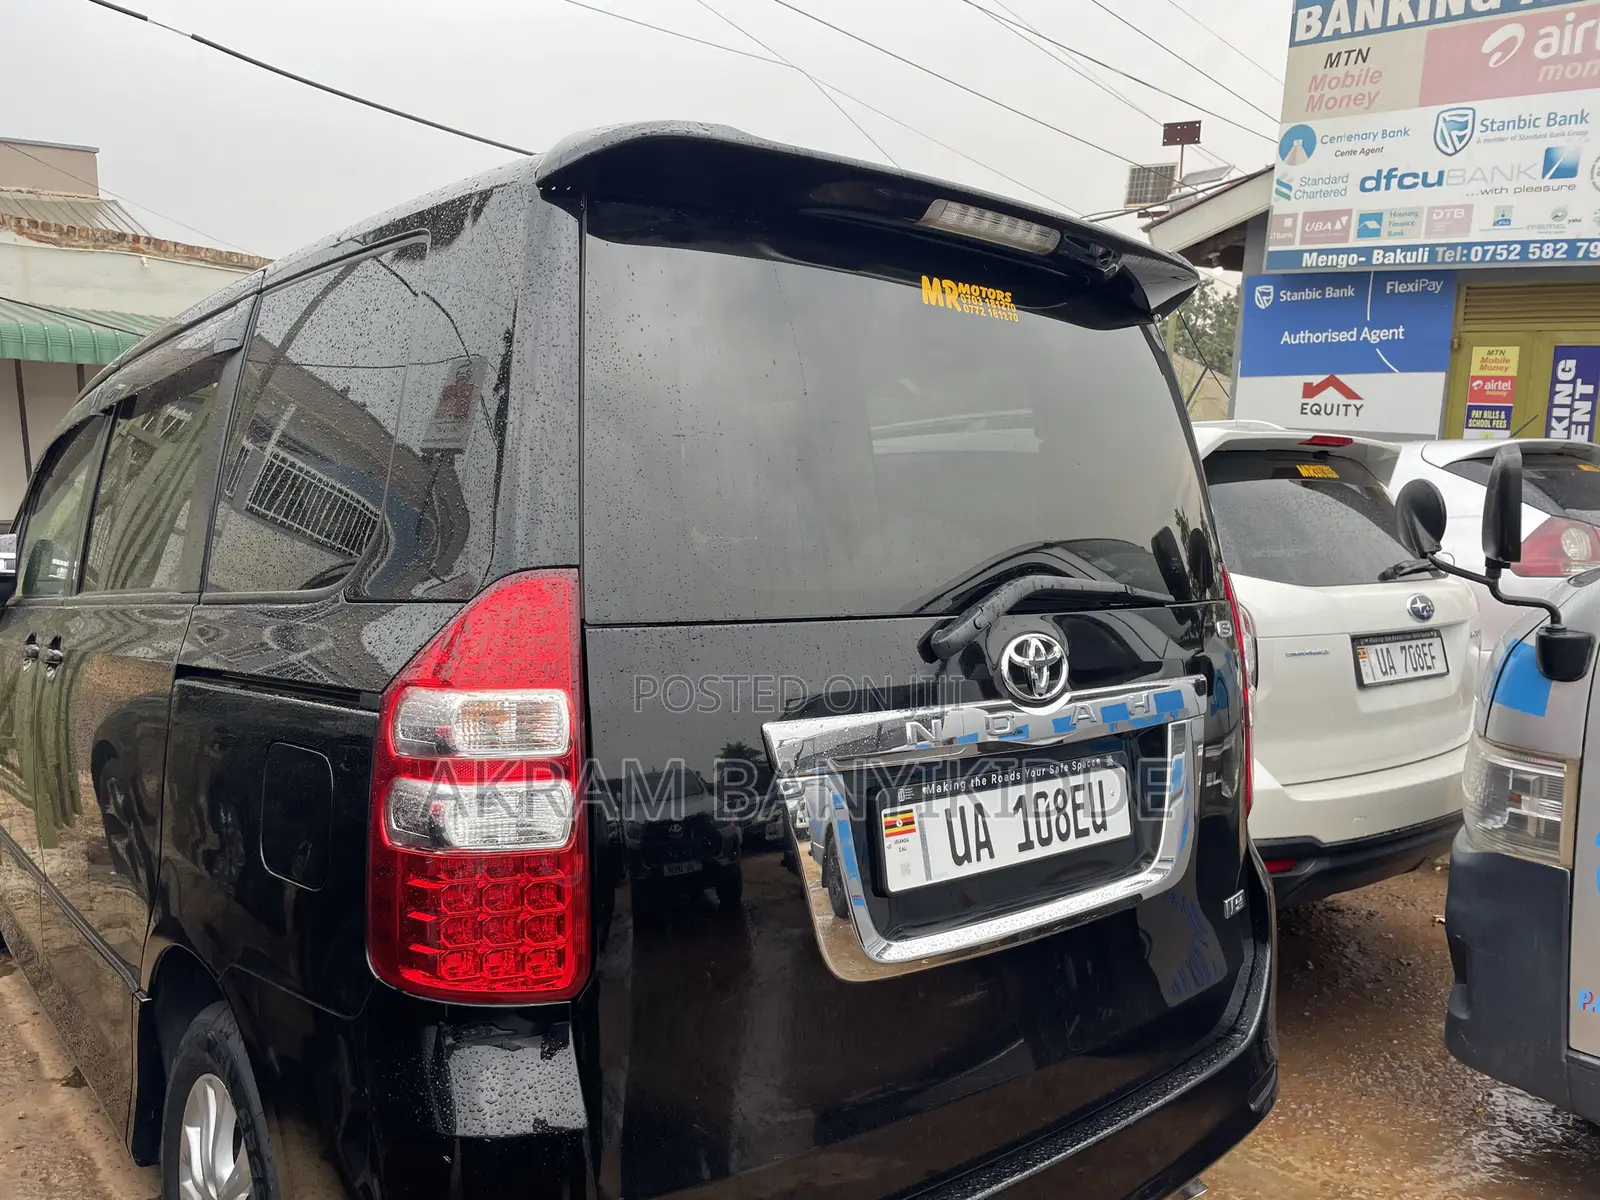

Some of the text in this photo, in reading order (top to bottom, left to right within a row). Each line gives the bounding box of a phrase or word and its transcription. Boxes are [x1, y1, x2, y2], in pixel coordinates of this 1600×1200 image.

[1534, 11, 1600, 59] air
[1323, 47, 1371, 69] MTN
[1307, 67, 1383, 94] Mobile
[1305, 89, 1381, 113] Money
[1480, 108, 1591, 133] Stanbic Bank
[1320, 127, 1411, 145] Centenary Bank
[1334, 146, 1384, 158] Cente Agent
[1300, 173, 1349, 187] Standard
[1513, 183, 1577, 195] pleasure
[1294, 186, 1347, 200] Chartered
[1433, 208, 1465, 220] DTB
[1305, 221, 1332, 232] UBA
[1302, 252, 1366, 268] Mengo-
[1372, 248, 1430, 265] Bakuli
[1528, 242, 1569, 259] 582
[921, 275, 1012, 312] MR MOTORS
[1279, 285, 1355, 301] Stanbic Bank
[1386, 279, 1444, 294] FlexiPay
[960, 293, 1017, 313] 0703 181270
[963, 305, 1019, 323] 0772 181270
[1280, 325, 1405, 345] Authorised Agent
[1479, 364, 1510, 372] Money
[1480, 356, 1511, 364] Mobile
[1484, 379, 1511, 391] airtel
[1550, 359, 1577, 439] KING
[1300, 403, 1364, 417] EQUITY
[1471, 410, 1483, 418] PAY
[1483, 410, 1500, 419] BILLS
[1570, 378, 1595, 442] ENT
[1468, 419, 1507, 428] SCHOOL FEES
[1375, 642, 1436, 677] UA 708EF
[905, 693, 1150, 744] NOAH
[971, 777, 987, 787] the
[991, 770, 1020, 784] Roads
[1025, 767, 1045, 778] Your
[1049, 763, 1069, 774] Safe
[944, 780, 1108, 867] UA 108EU
[1578, 988, 1600, 1014] P.
